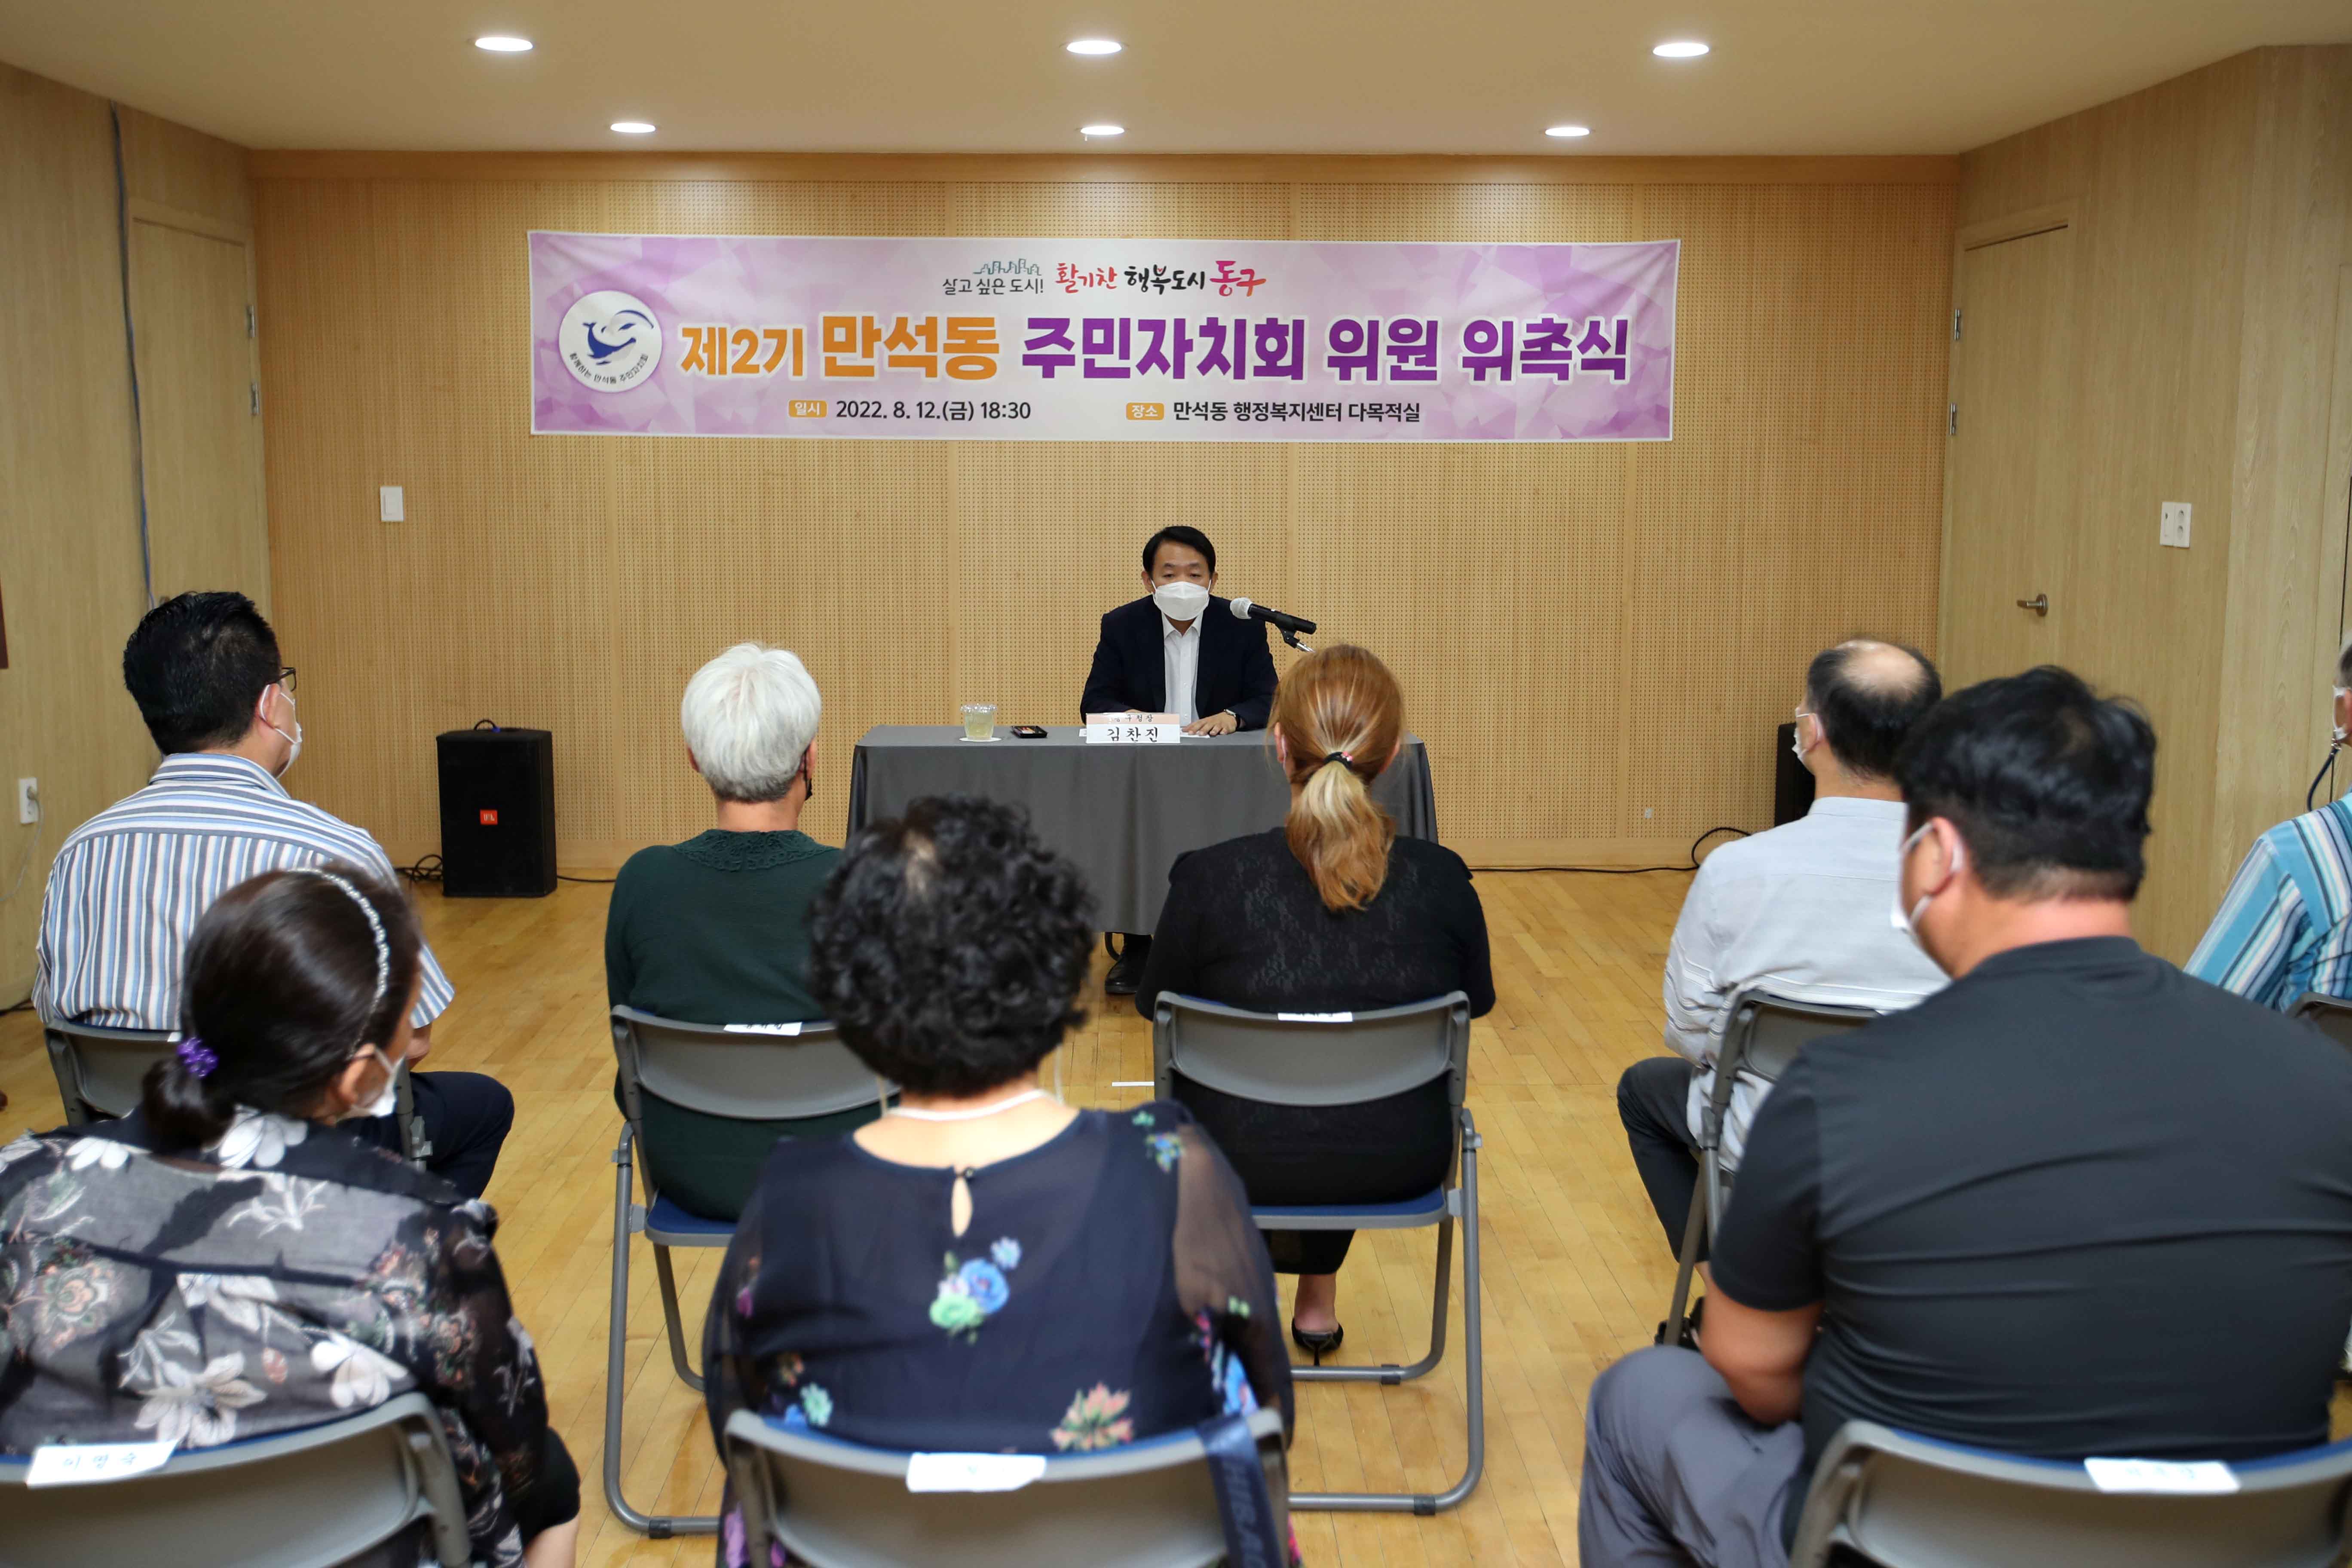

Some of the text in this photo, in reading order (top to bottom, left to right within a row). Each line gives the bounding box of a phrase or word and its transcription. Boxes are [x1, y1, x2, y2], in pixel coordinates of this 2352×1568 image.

[943, 279, 1044, 295] 살고 싶은 도시!
[1055, 260, 1267, 297] 활기찬 행복도시 동구
[680, 315, 1628, 381] 제2기 만석동 주민자치회 위원 위촉식
[795, 402, 821, 415] 일시
[836, 401, 1031, 421] 2022. 8. 12.(금) 18:30
[1131, 404, 1158, 418] 장소
[1173, 402, 1421, 423] 만석동 행정복지센터 다목적실
[1107, 726, 1158, 743] 김찬진
